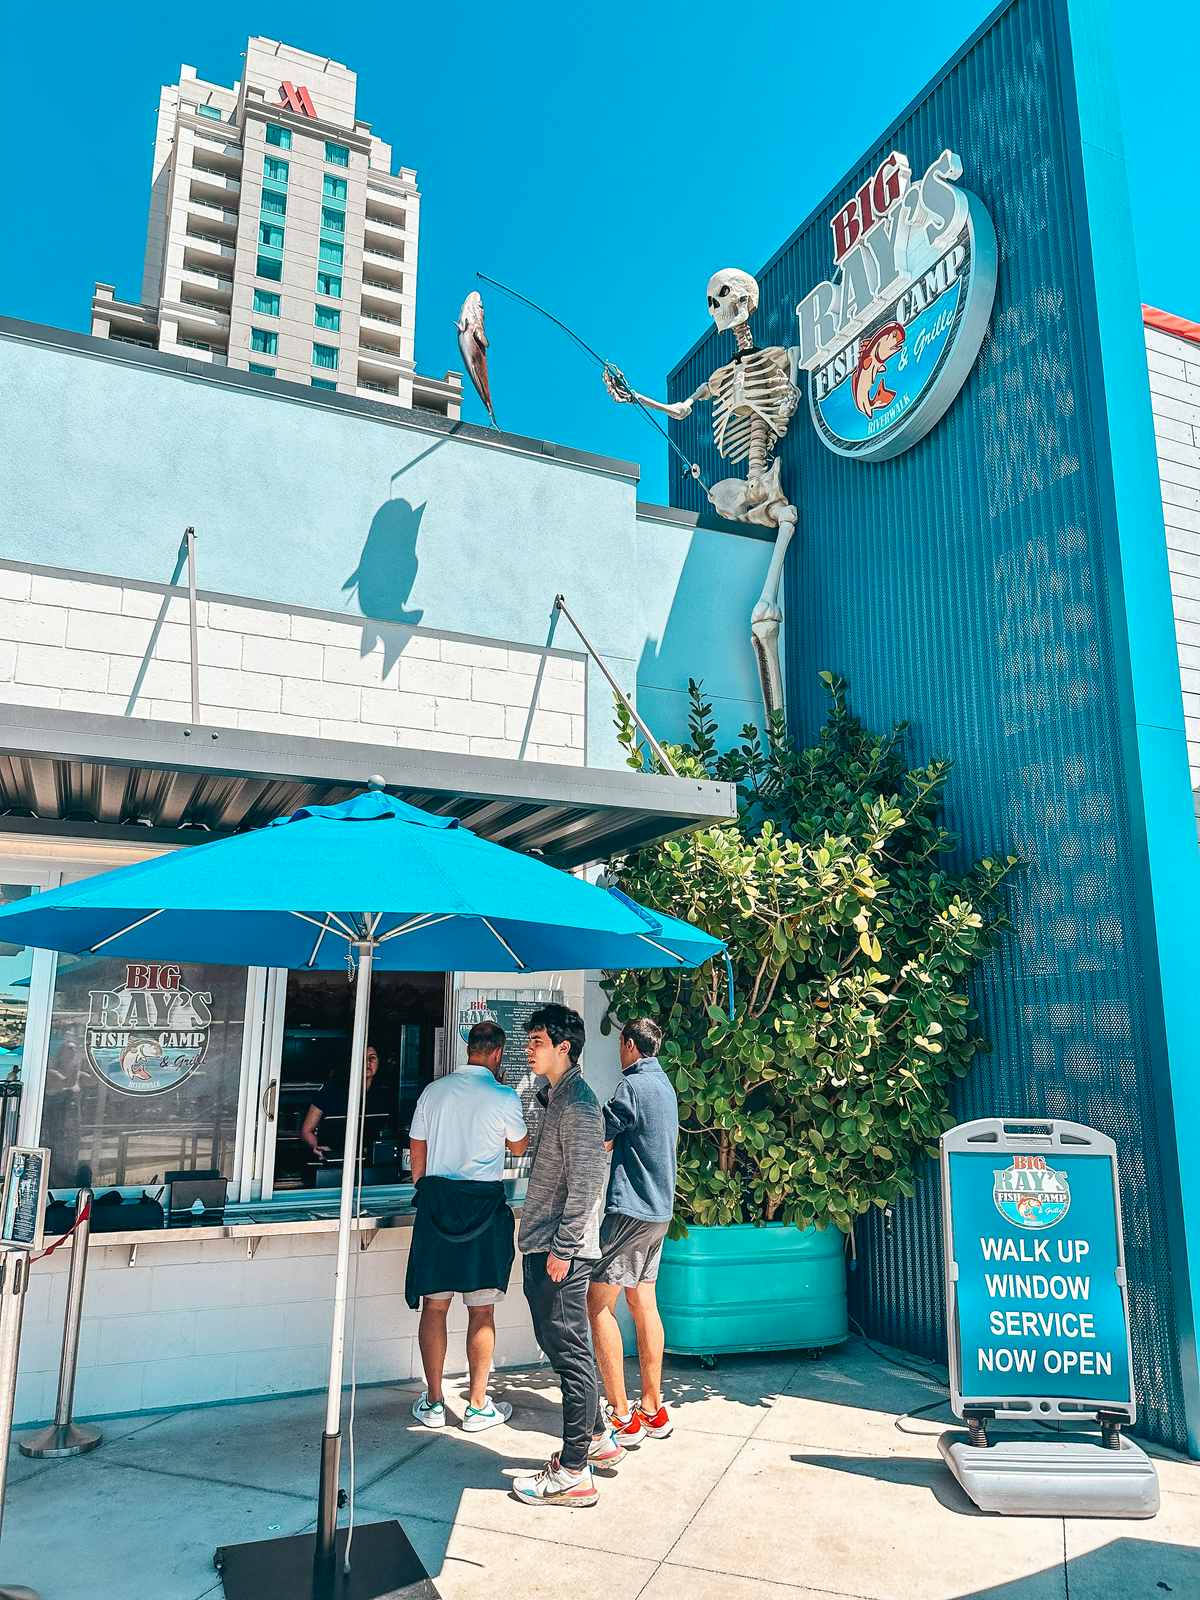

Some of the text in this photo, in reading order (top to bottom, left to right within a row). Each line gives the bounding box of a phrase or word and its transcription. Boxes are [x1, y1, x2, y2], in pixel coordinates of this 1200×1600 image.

[832, 152, 903, 264] BIG
[798, 150, 963, 369] RAY'S
[815, 246, 966, 400] FISH CAMP
[897, 308, 954, 372] & Grille
[867, 393, 911, 435] RIVERWALK
[125, 965, 181, 990] BIG
[87, 991, 212, 1029] RAY'S
[470, 1001, 486, 1010] BIG
[90, 1032, 206, 1047] FISH CAMP
[160, 1057, 169, 1068] &
[1013, 1156, 1046, 1170] BIG
[993, 1169, 1068, 1192] RAY'S
[998, 1193, 1067, 1204] FISH CAMP
[980, 1238, 1089, 1263] WALK UP
[985, 1274, 1090, 1300] WINDOW
[990, 1311, 1096, 1338] SERVICE
[977, 1348, 1112, 1375] NOW OPEN
